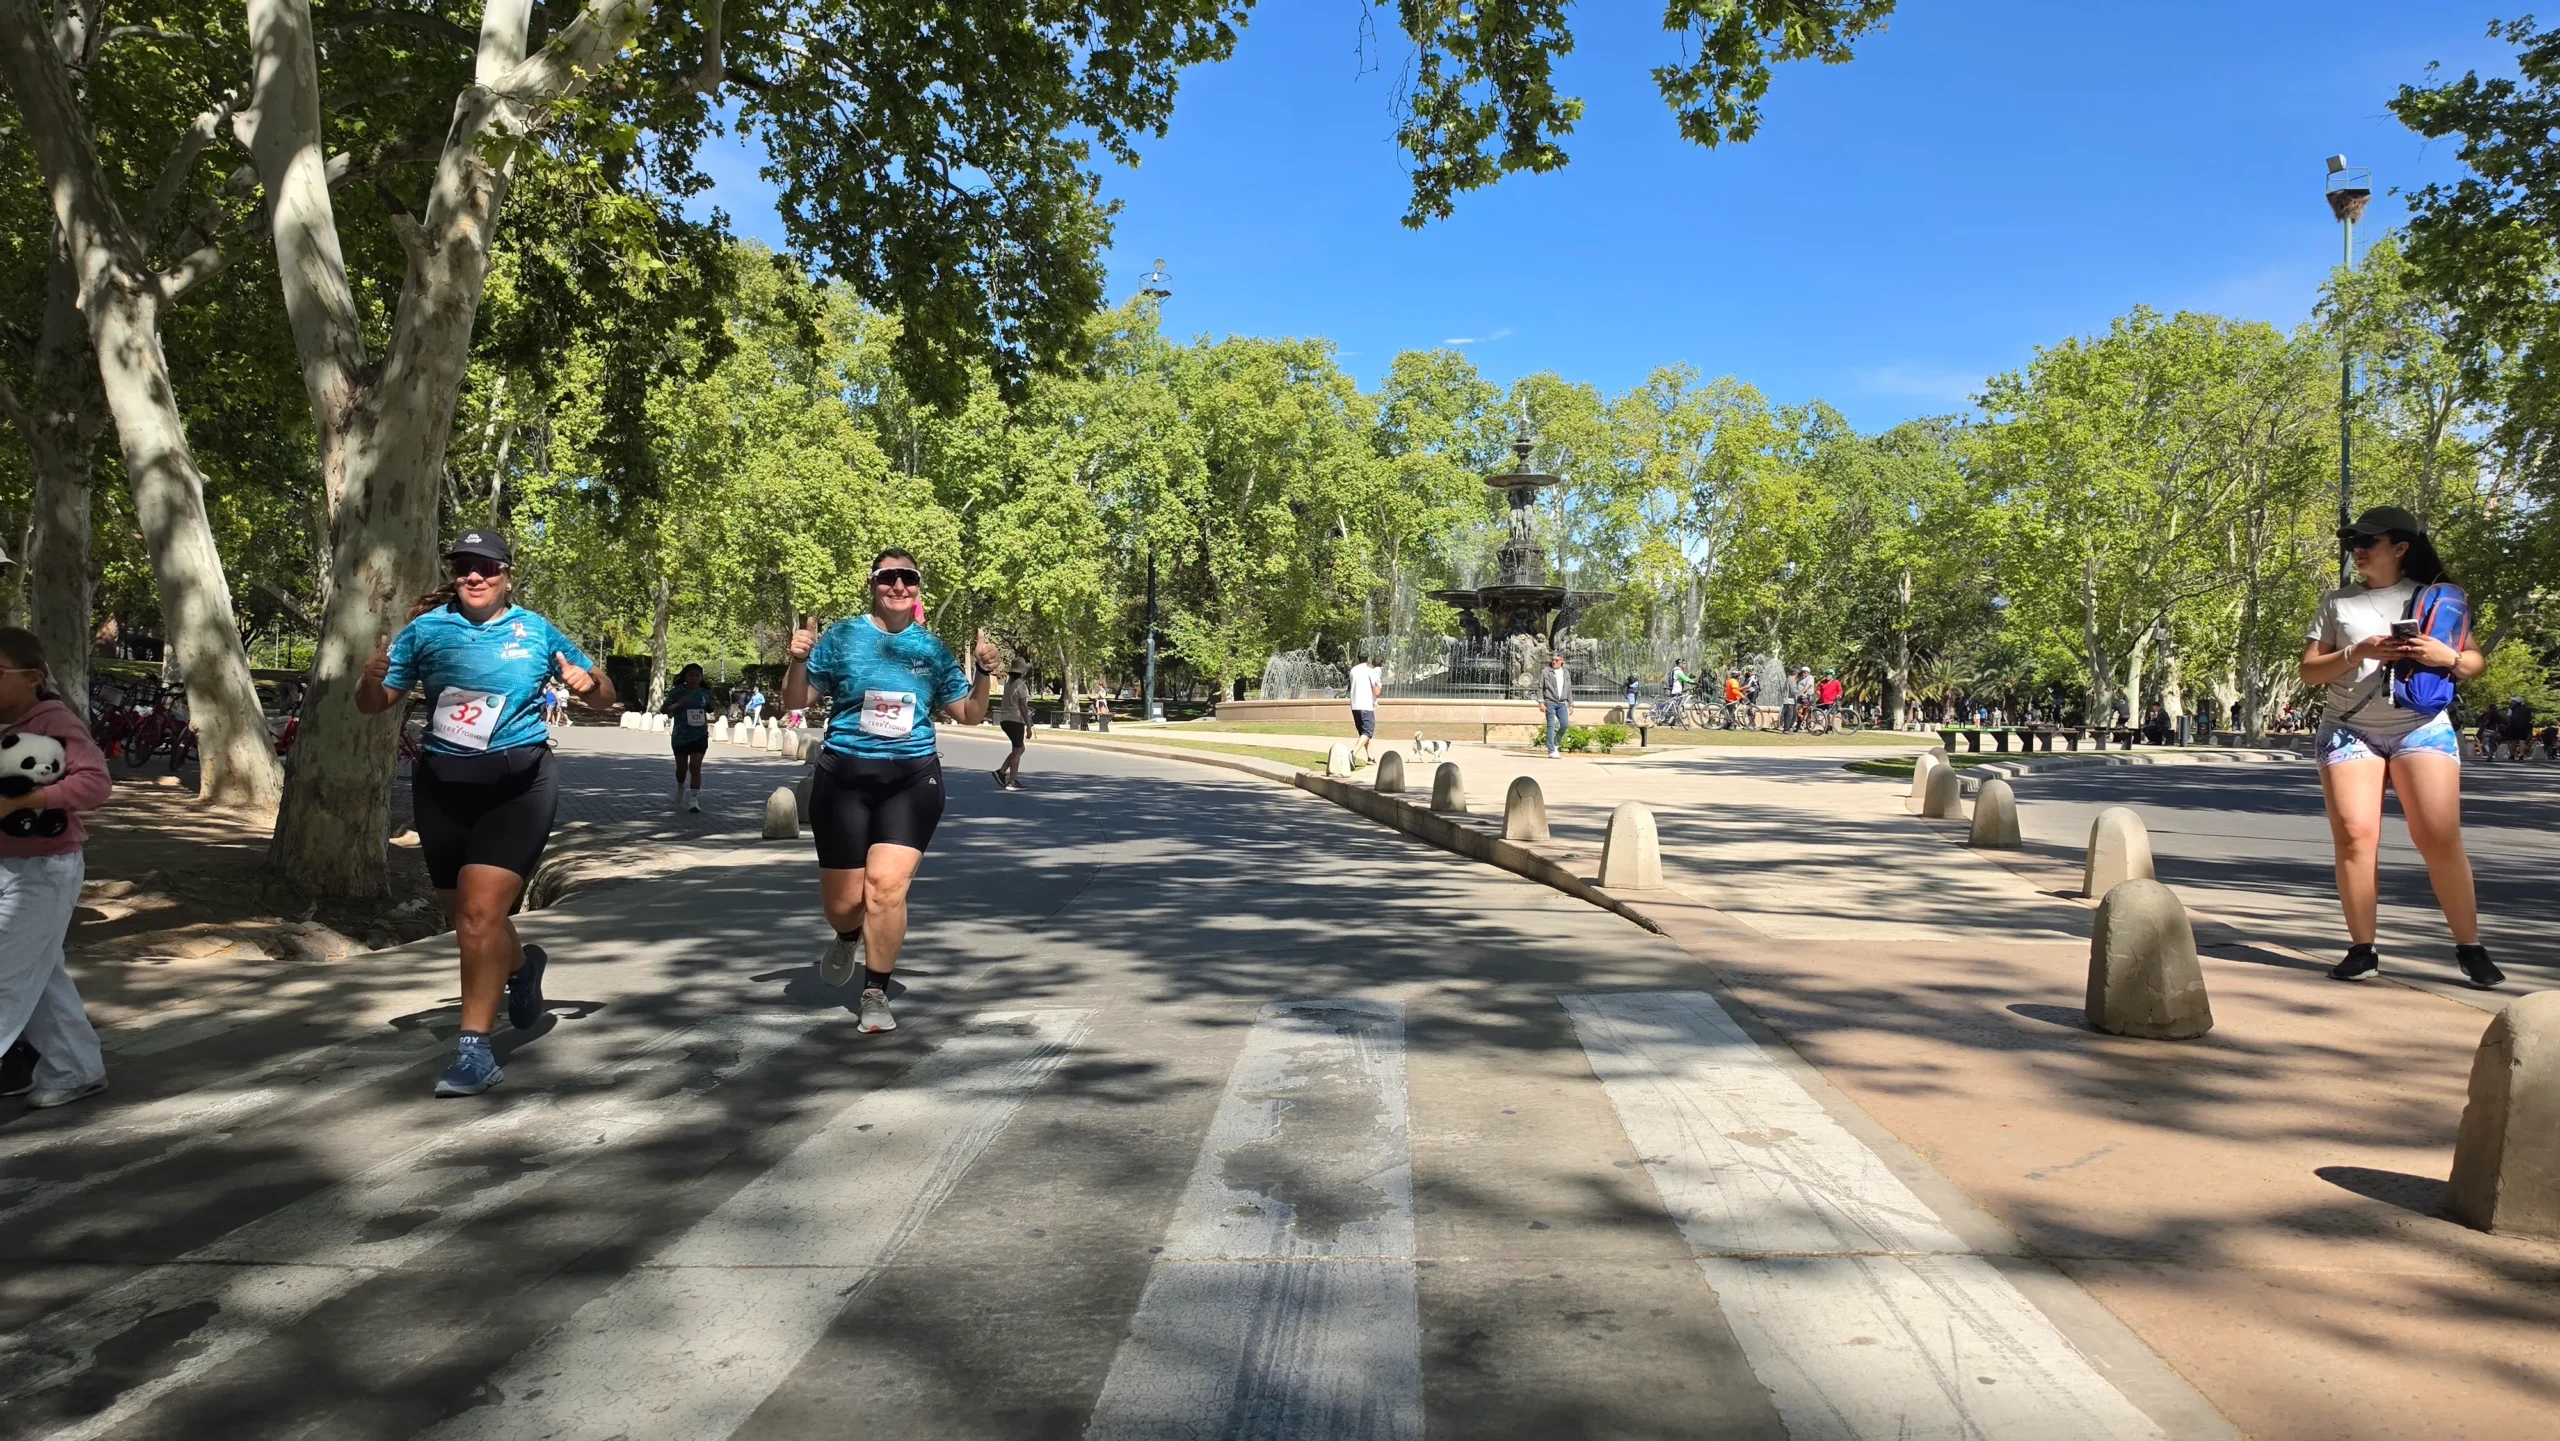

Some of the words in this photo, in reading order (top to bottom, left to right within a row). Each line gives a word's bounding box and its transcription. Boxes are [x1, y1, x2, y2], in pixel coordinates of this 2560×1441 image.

[450, 702, 482, 726] 32
[875, 703, 901, 720] 93
[440, 724, 482, 739] TERRITORIO
[868, 720, 906, 731] TERRITORIO
